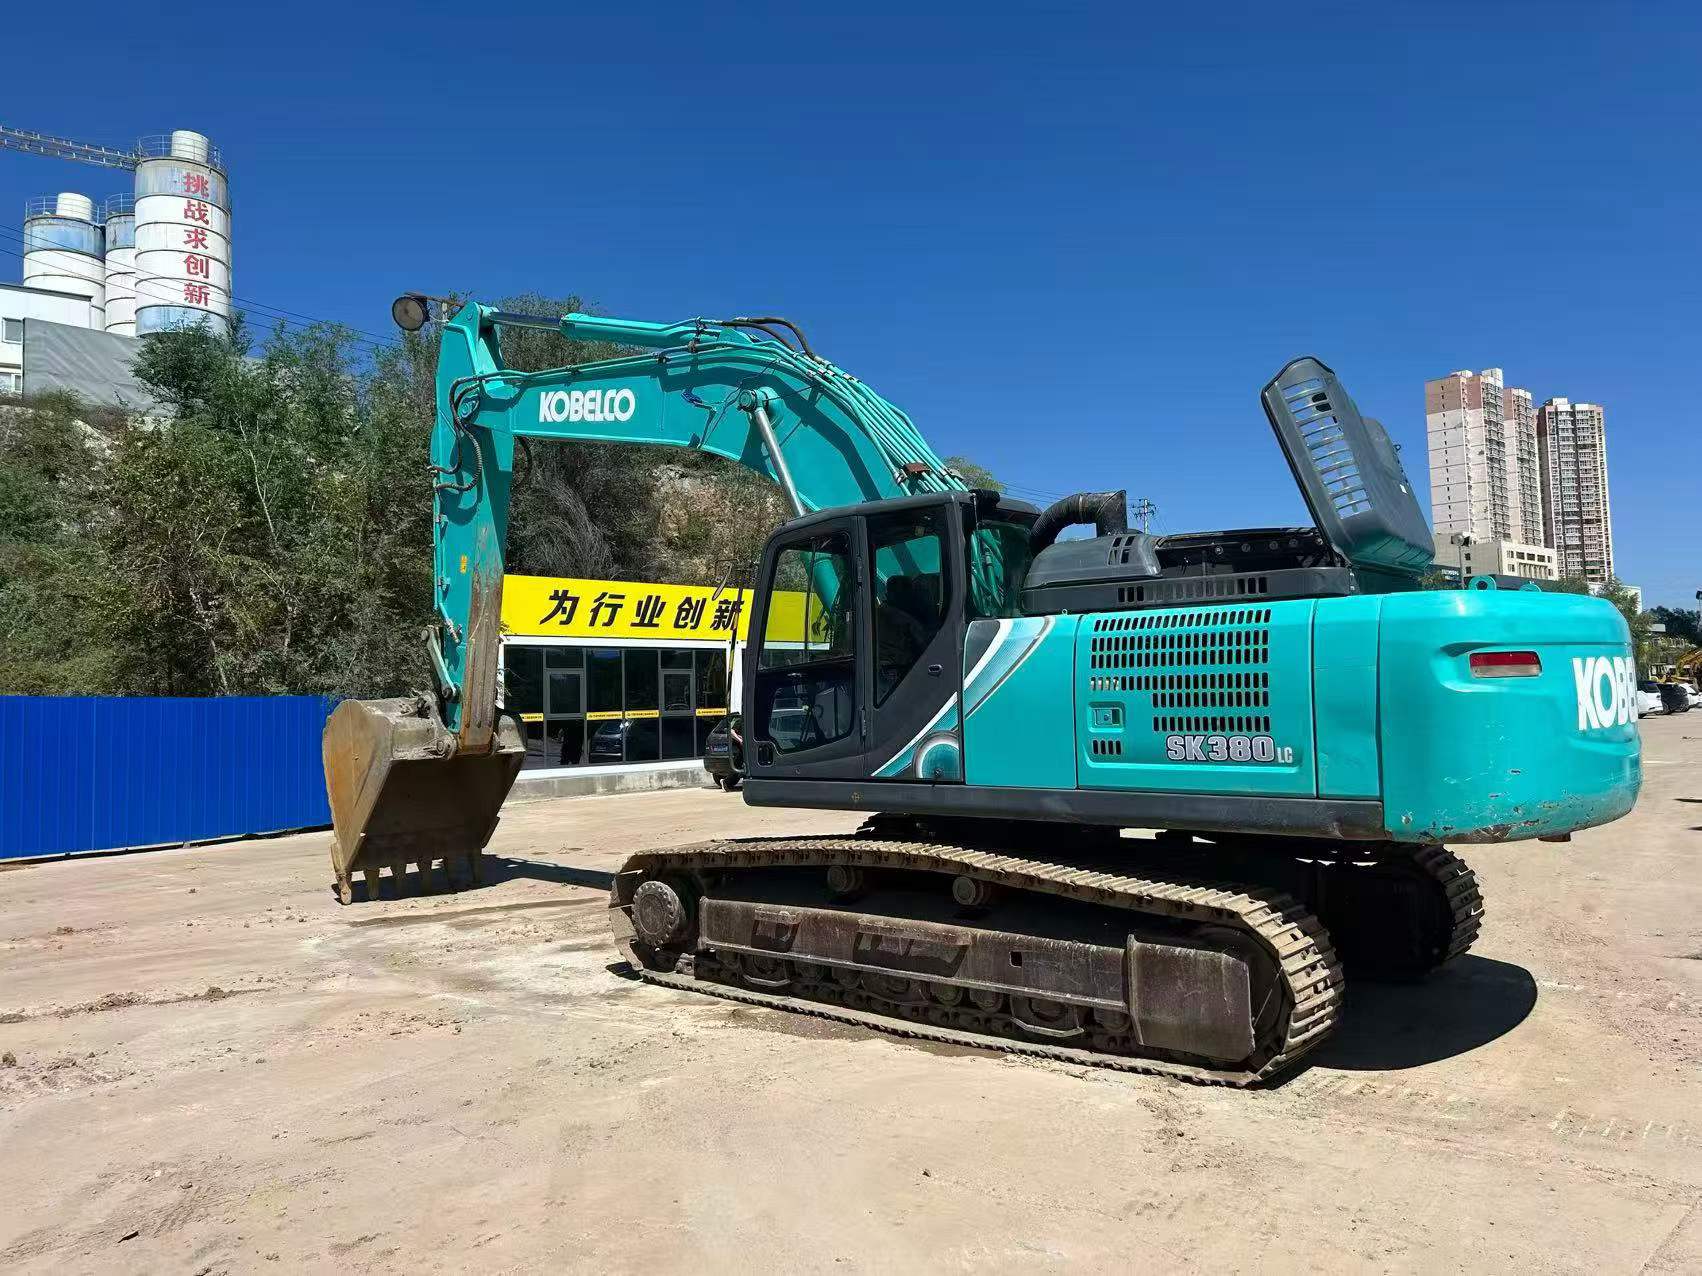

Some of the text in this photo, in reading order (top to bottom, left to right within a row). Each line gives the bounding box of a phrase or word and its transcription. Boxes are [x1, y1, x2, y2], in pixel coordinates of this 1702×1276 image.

[183, 171, 210, 307] 挑战求创新
[539, 388, 635, 423] KOBELCO
[539, 589, 745, 631] 为行业创新
